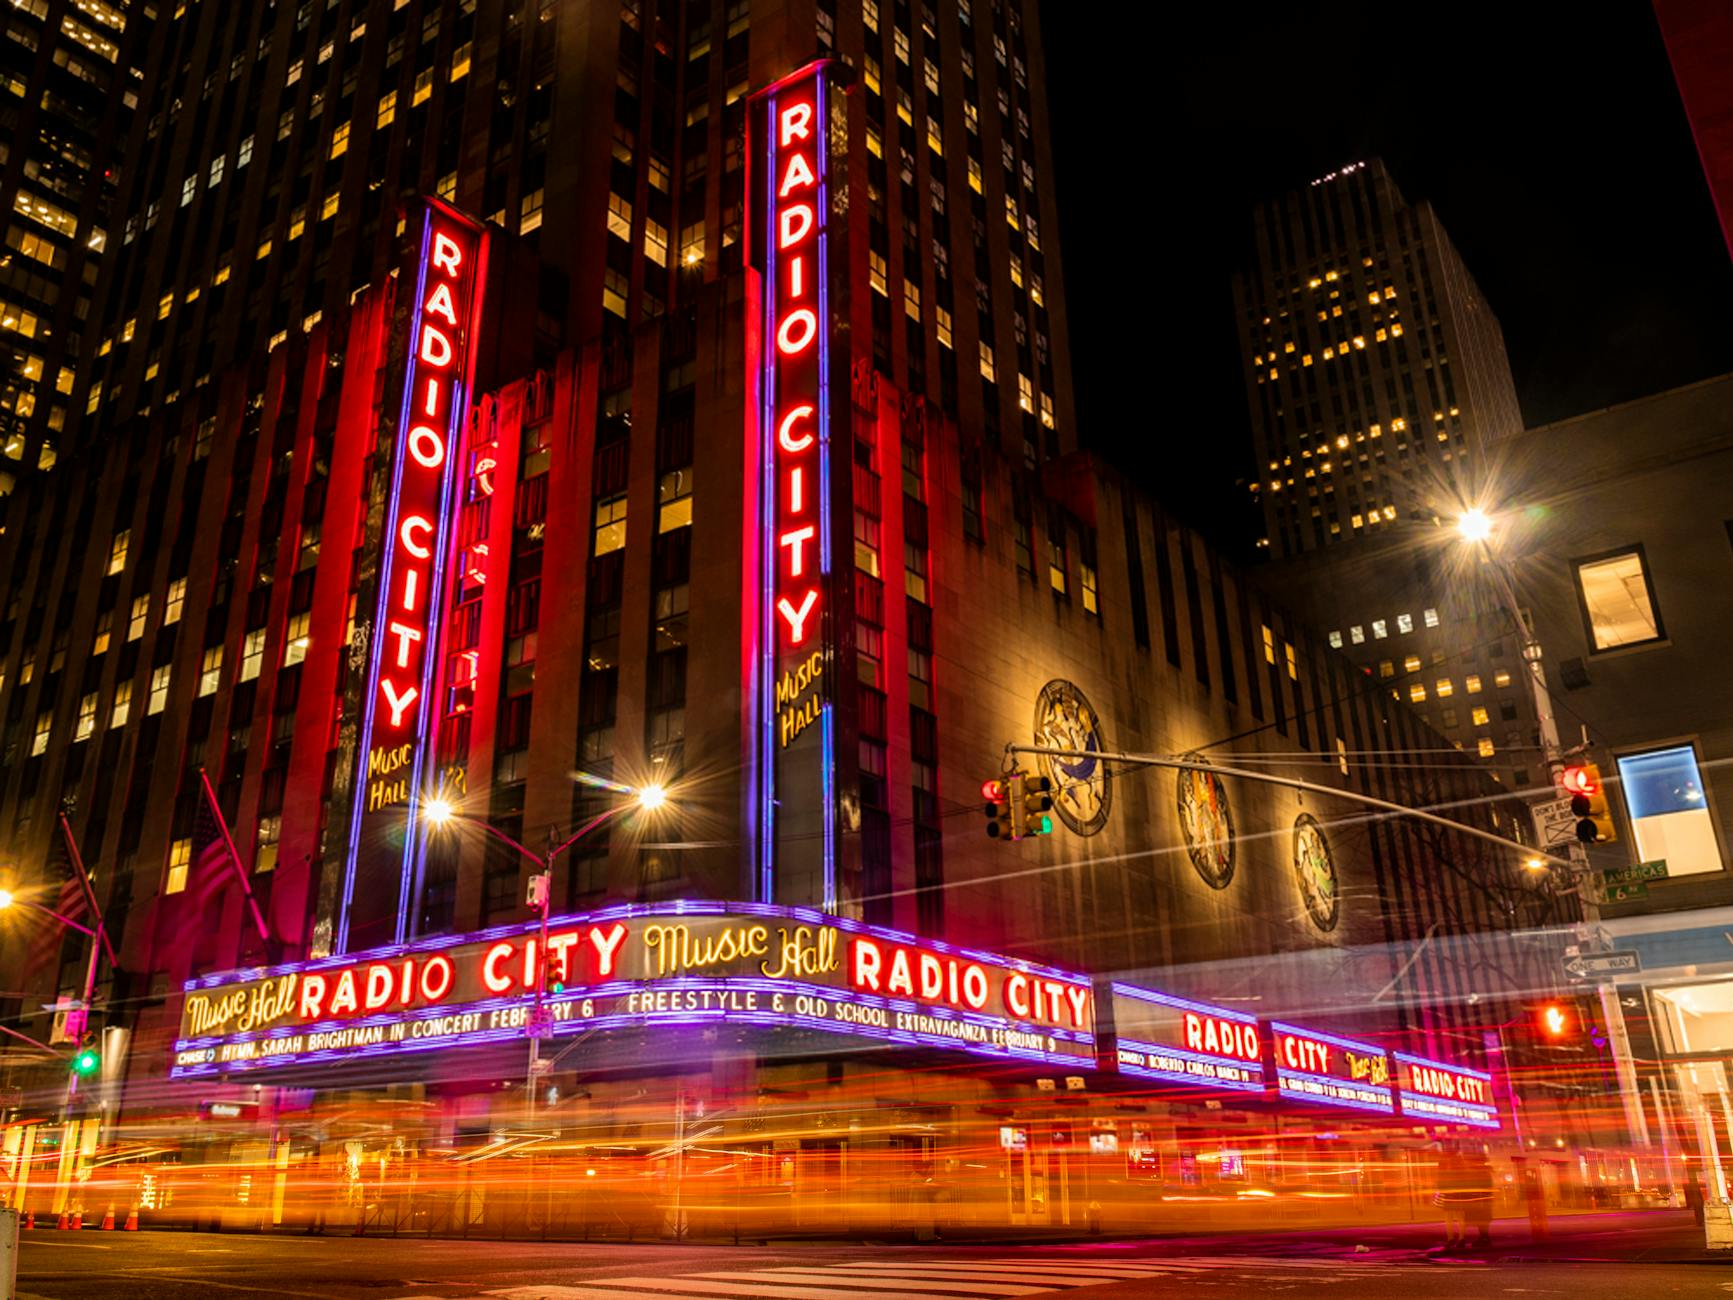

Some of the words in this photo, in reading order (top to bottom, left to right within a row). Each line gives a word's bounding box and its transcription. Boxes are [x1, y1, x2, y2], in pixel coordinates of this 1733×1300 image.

[777, 102, 816, 354] RADIO
[408, 232, 462, 468] RADIO
[777, 406, 818, 643] CITY
[381, 515, 433, 727] CITY
[1555, 801, 1571, 811] BLO
[1608, 865, 1665, 883] AMERICAS
[1616, 887, 1627, 901] 6
[237, 973, 298, 1032] Hall
[300, 955, 450, 1018] RADIO
[483, 923, 626, 993] CITY
[644, 924, 769, 975] Music
[761, 927, 840, 978] Hall
[855, 939, 988, 1009] RADIO
[1007, 975, 1087, 1027] CITY
[1571, 960, 1594, 972] ONE
[1607, 958, 1631, 968] WAY
[177, 1050, 206, 1064] CHASE
[261, 1036, 301, 1056] SARAH
[308, 1026, 383, 1052] BRIGHTMAN
[390, 1022, 405, 1041] IN
[412, 1013, 482, 1037] CONCERT
[582, 998, 593, 1018] 6
[628, 990, 757, 1012] FREESTYLE
[772, 993, 785, 1012] &
[796, 995, 828, 1017] OLD
[835, 1003, 889, 1028] SCHOOL
[896, 1013, 988, 1042] EXTRAVAGANZA
[992, 1031, 1043, 1051] FEBRUARY
[1185, 1013, 1258, 1060] RADIO
[1149, 1055, 1185, 1073] ROBERTO
[1187, 1061, 1216, 1077] CARLOS
[1284, 1036, 1328, 1074] CITY
[1411, 1064, 1454, 1098] RADIO
[1456, 1075, 1484, 1103] CITY
